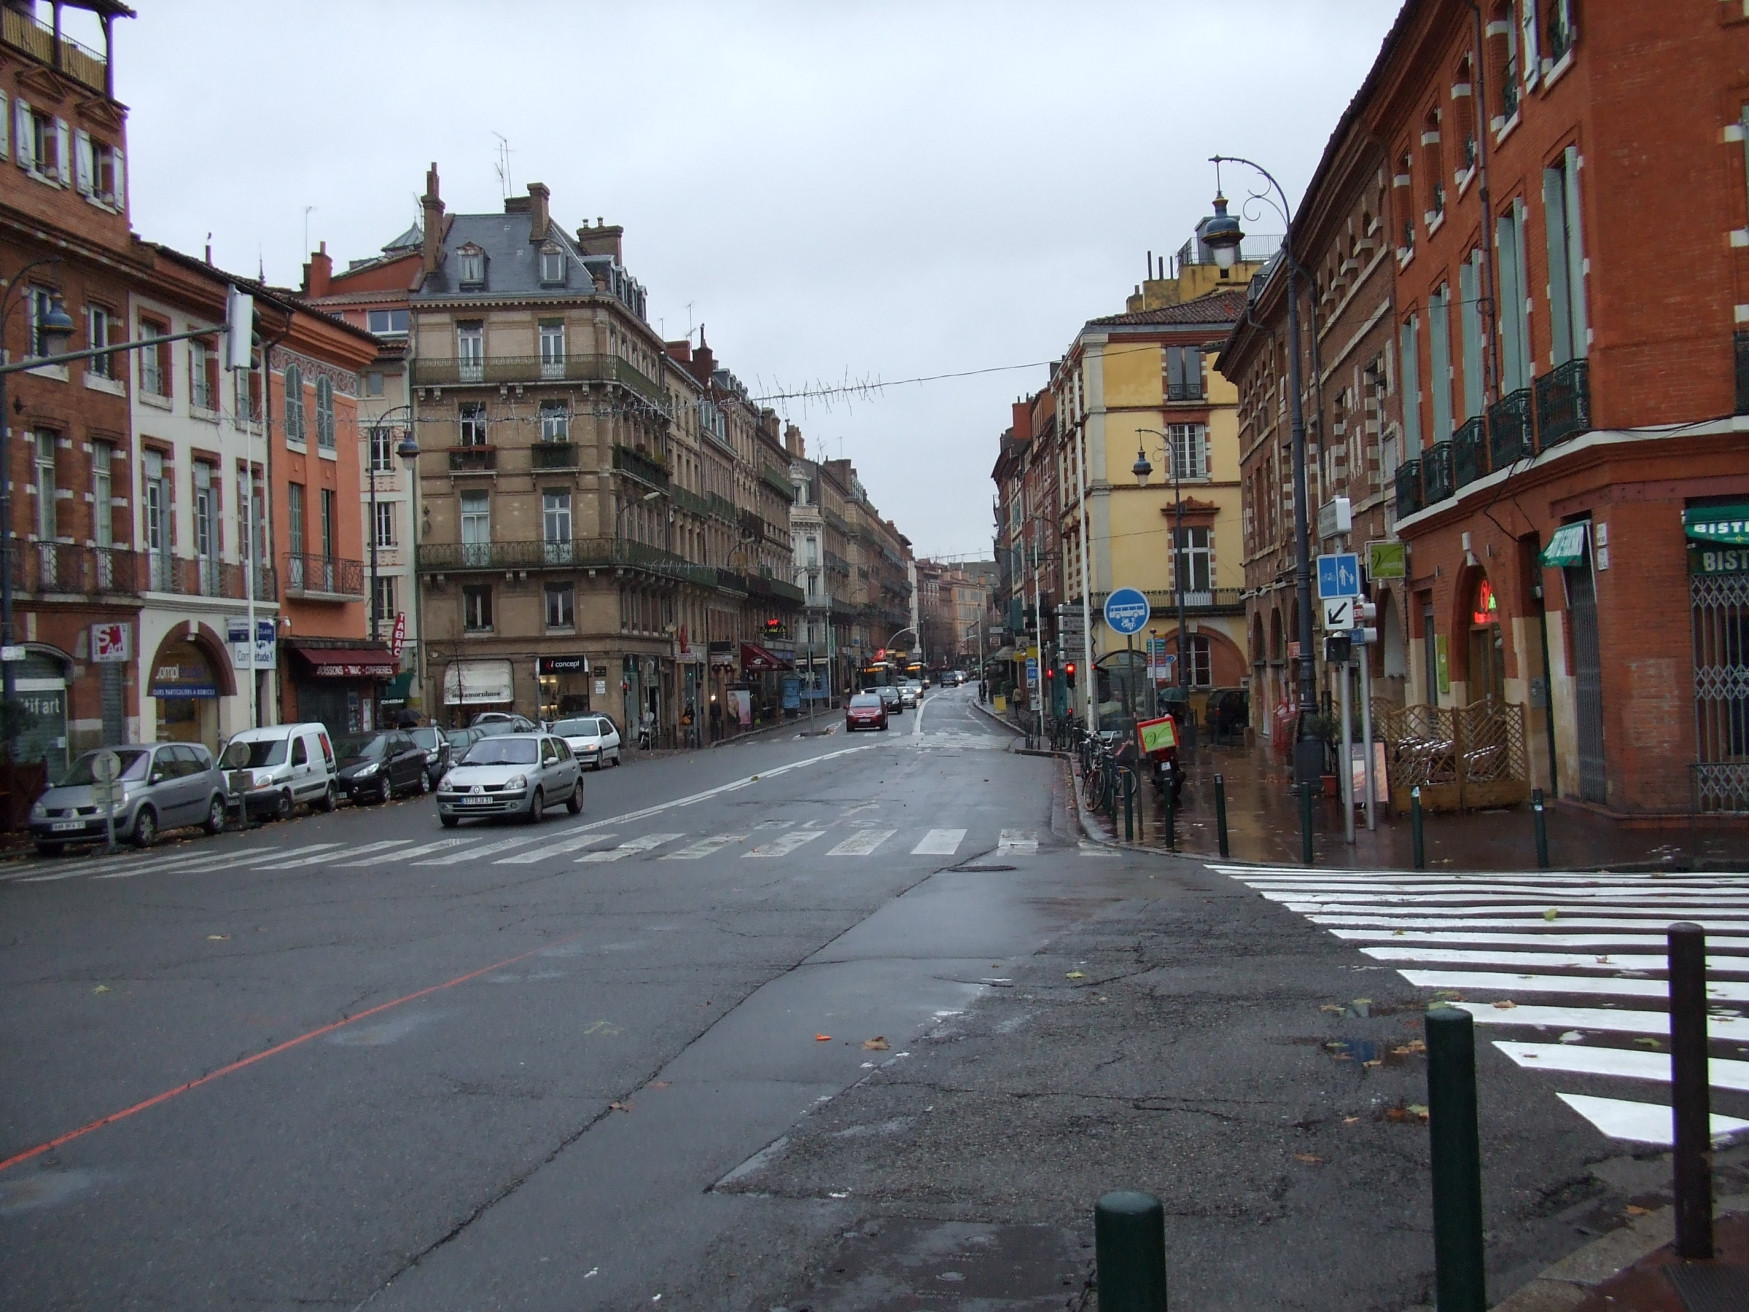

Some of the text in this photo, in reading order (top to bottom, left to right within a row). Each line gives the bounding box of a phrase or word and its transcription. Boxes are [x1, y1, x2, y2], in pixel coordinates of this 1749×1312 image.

[393, 613, 405, 656] TABAC
[316, 665, 344, 675] BOISSONS
[554, 660, 580, 670] concept
[42, 697, 61, 715] art
